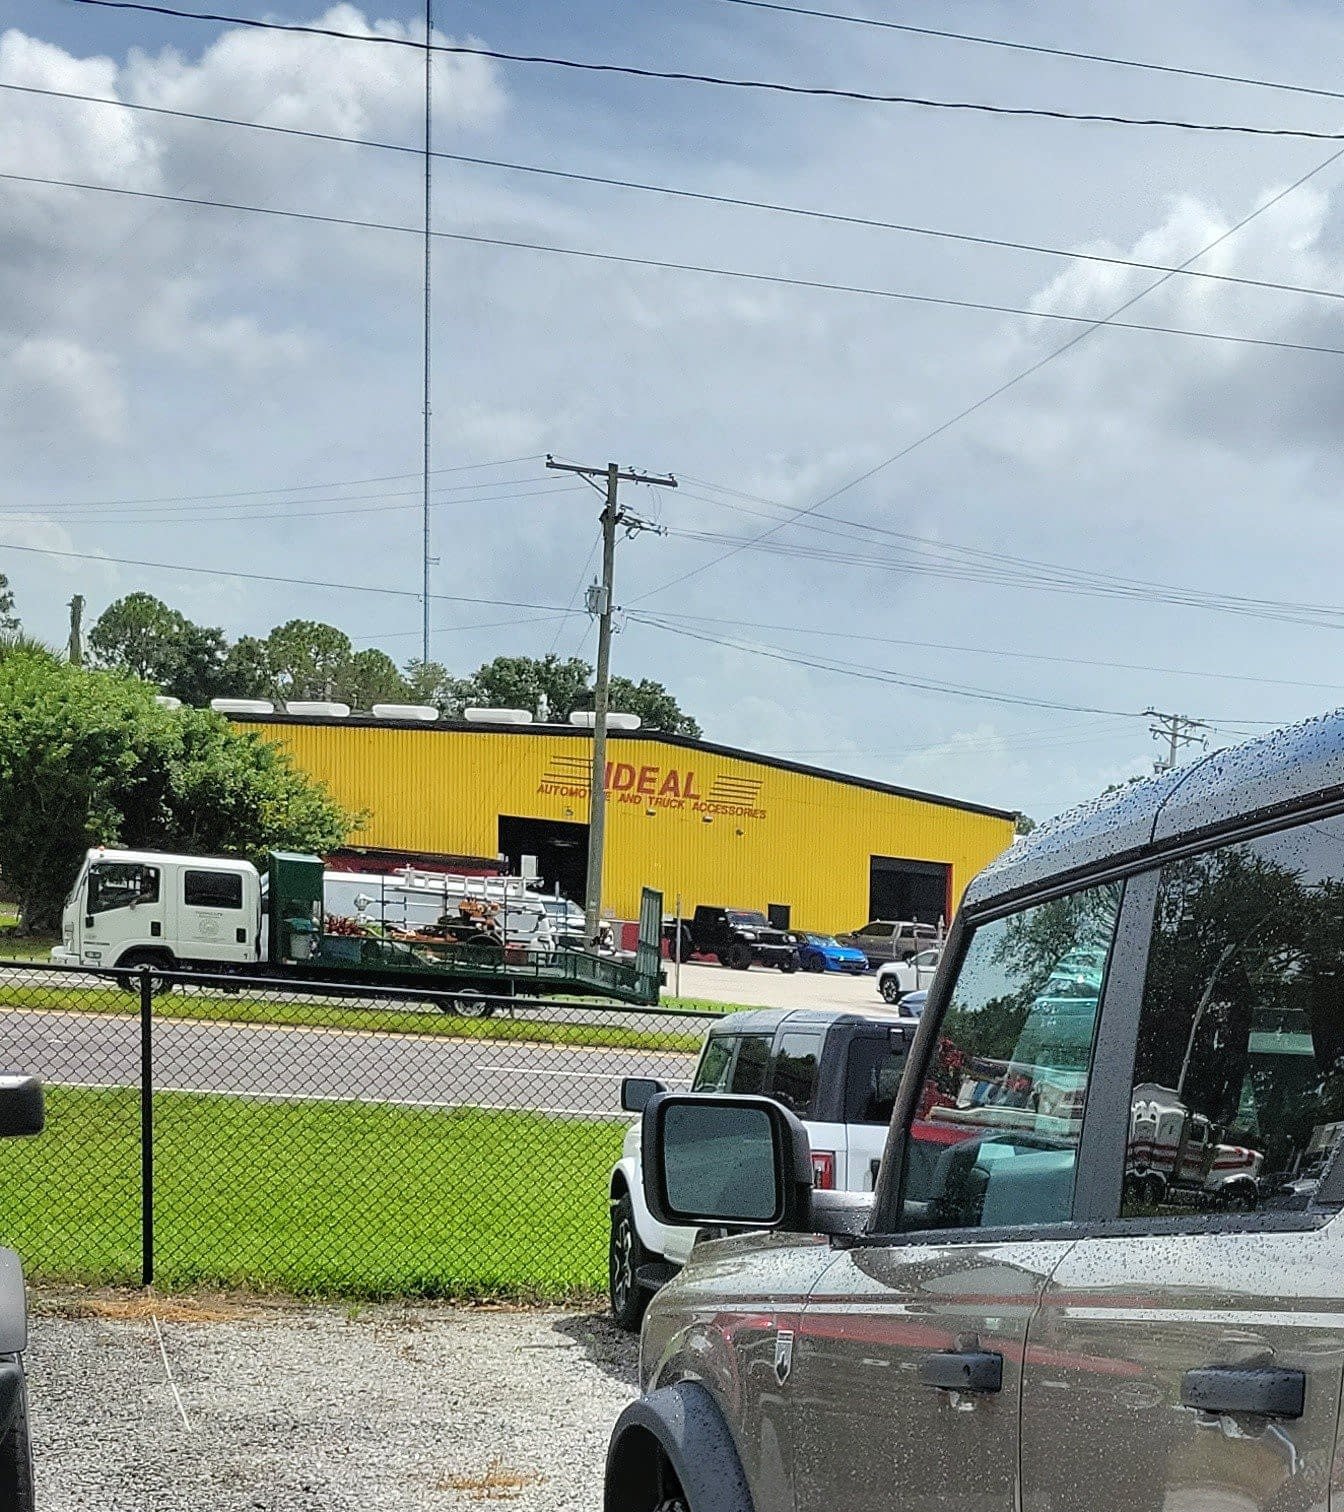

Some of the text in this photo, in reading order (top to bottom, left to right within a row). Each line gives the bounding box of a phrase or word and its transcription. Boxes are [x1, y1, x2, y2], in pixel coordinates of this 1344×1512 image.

[604, 761, 701, 800] IDEAL
[618, 793, 642, 805] AND
[649, 796, 685, 811] TRUCK
[692, 802, 767, 820] ACCESSORIES
